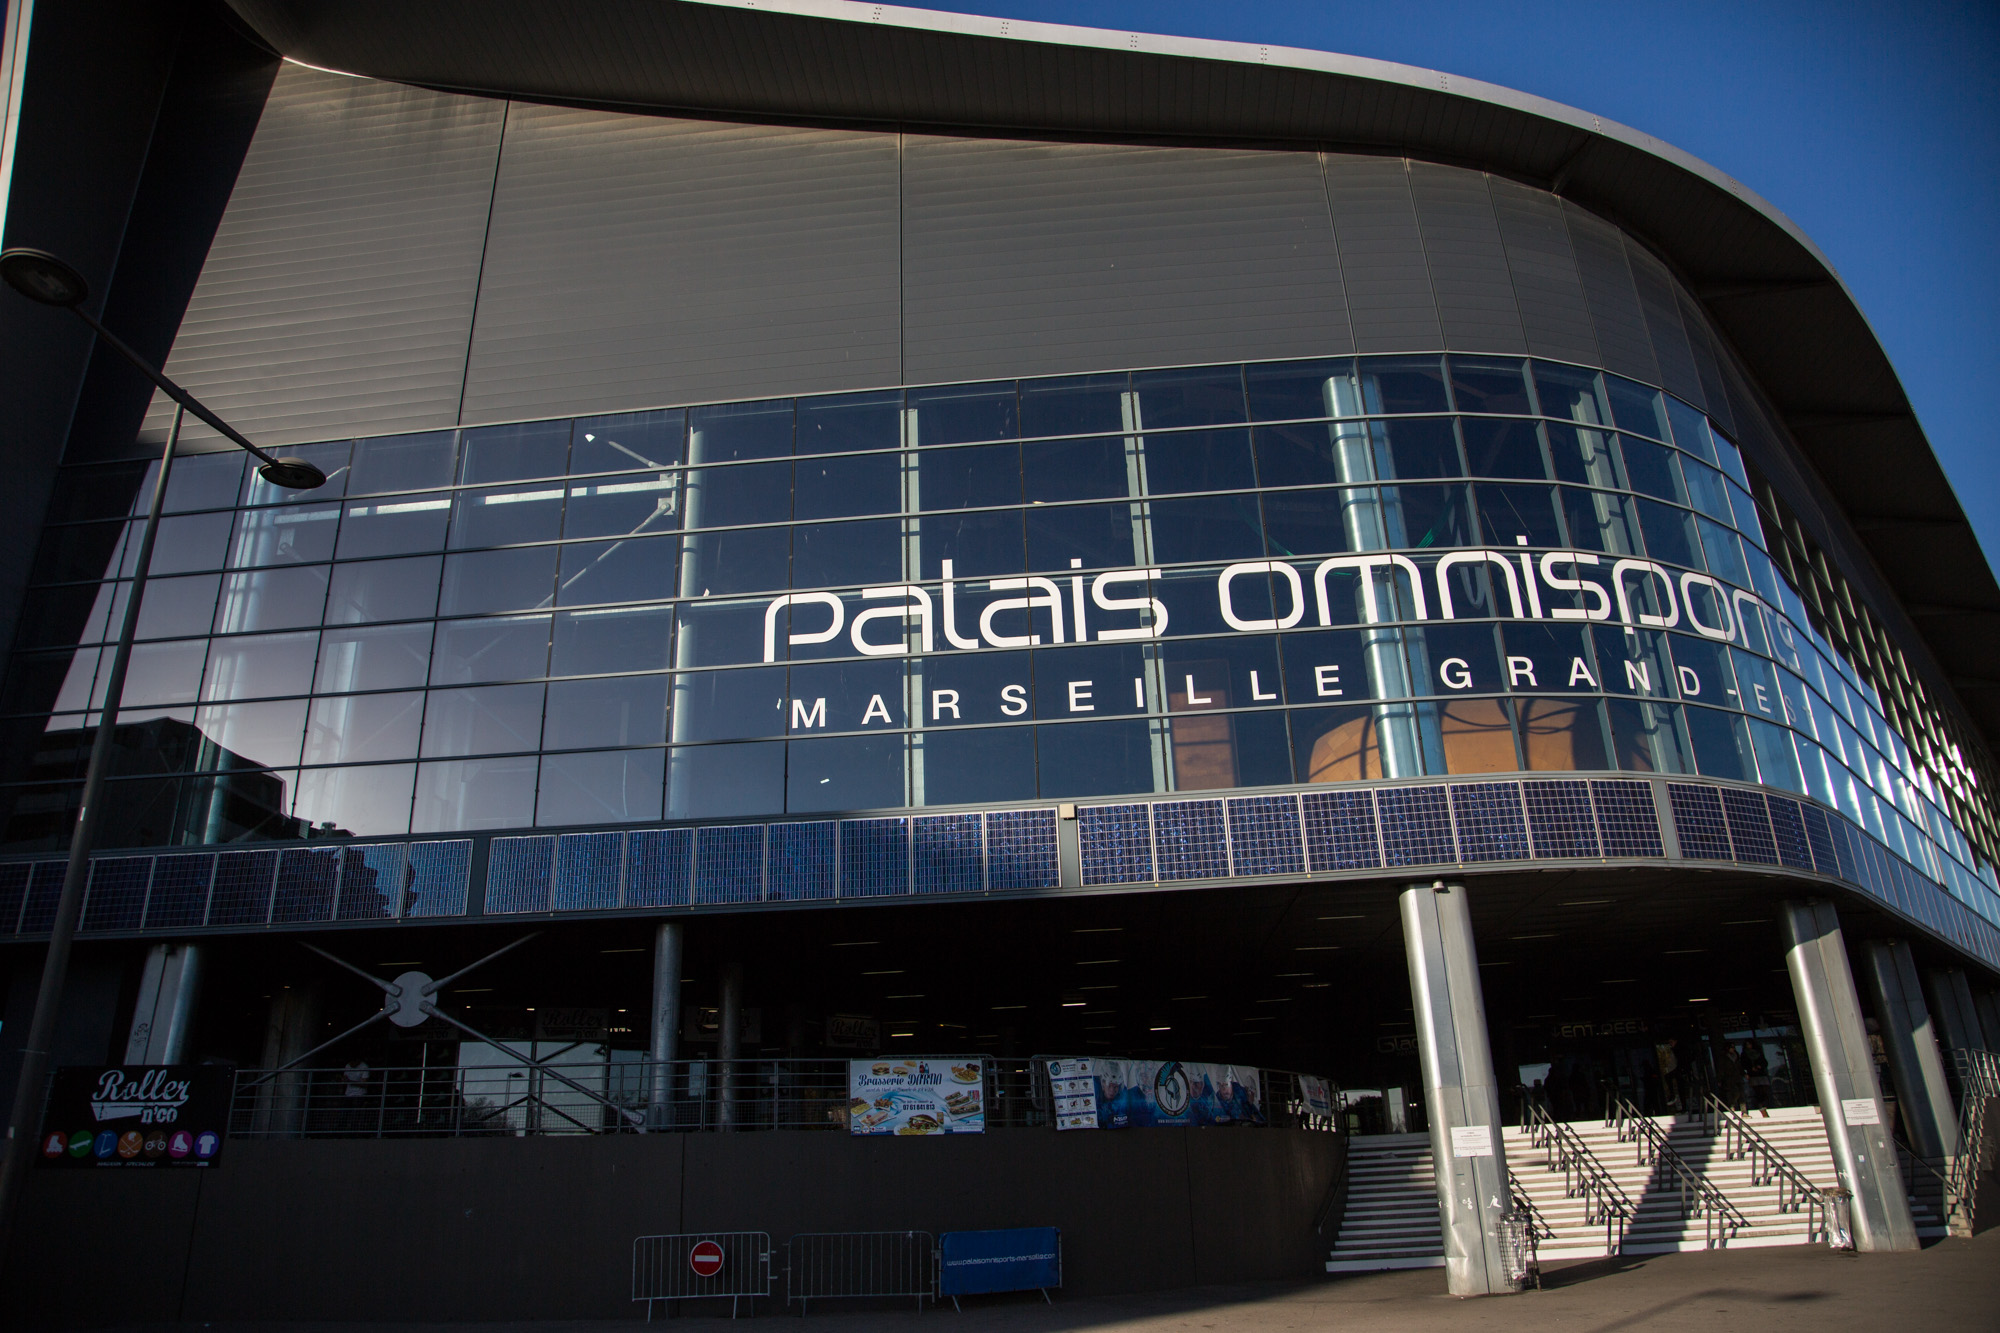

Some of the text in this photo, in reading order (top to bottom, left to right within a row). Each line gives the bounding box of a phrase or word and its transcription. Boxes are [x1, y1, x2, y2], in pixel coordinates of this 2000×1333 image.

[764, 535, 1806, 678] Palais omnisports
[791, 664, 1344, 729] MARSEILLE
[92, 1069, 191, 1101] Roller
[858, 1074, 905, 1086] Brasserie
